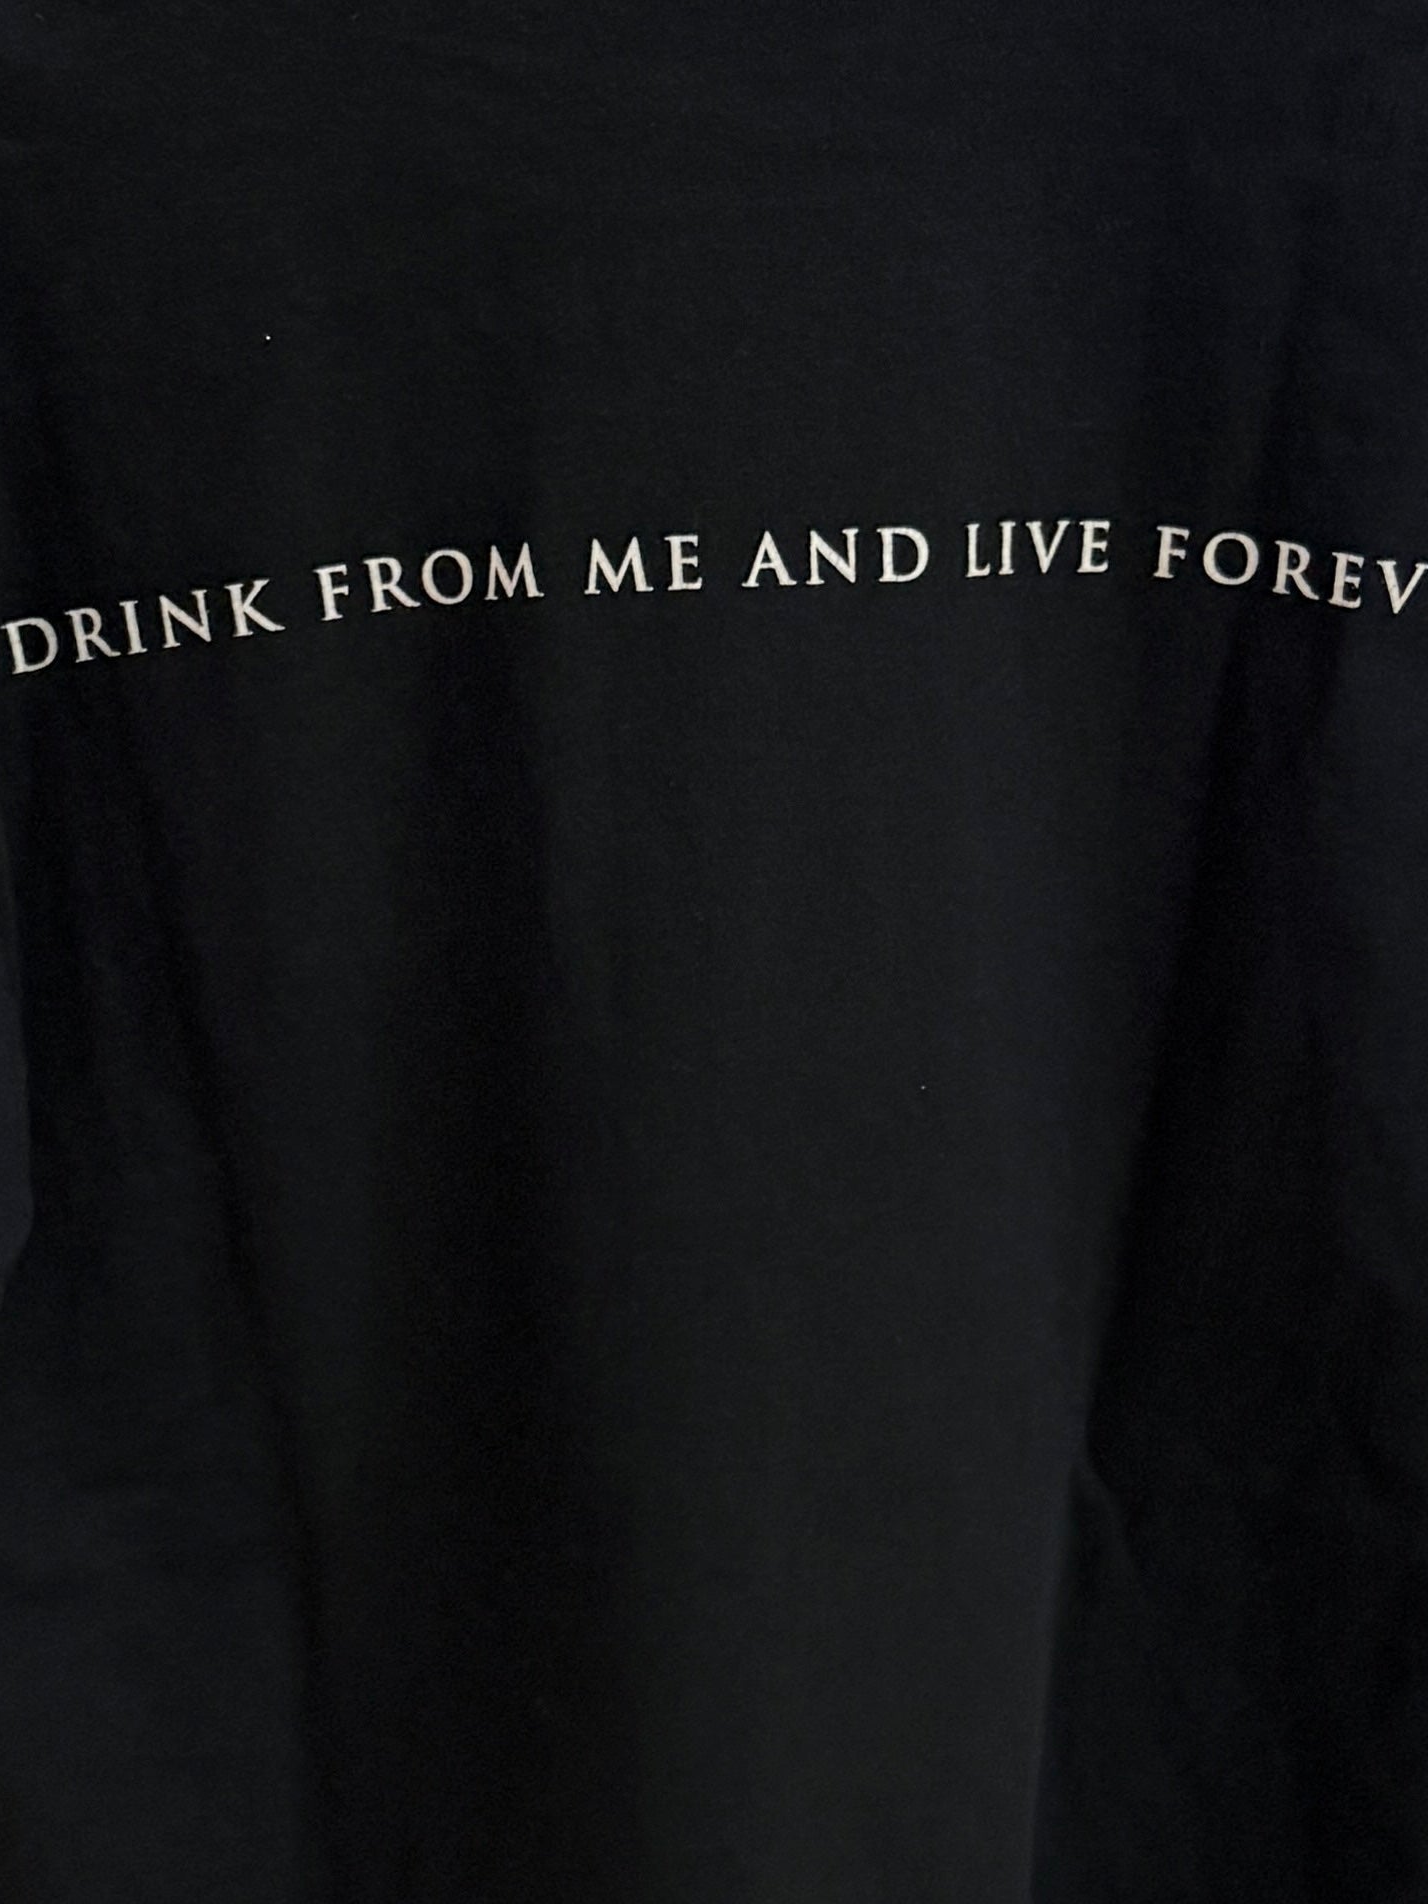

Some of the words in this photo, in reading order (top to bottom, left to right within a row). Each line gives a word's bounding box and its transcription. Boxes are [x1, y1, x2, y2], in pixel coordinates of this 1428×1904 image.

[0, 578, 287, 675] DRINK
[313, 541, 546, 622] FROM
[583, 533, 704, 596] ME
[740, 525, 931, 589] AND
[965, 518, 1112, 579] LIVE
